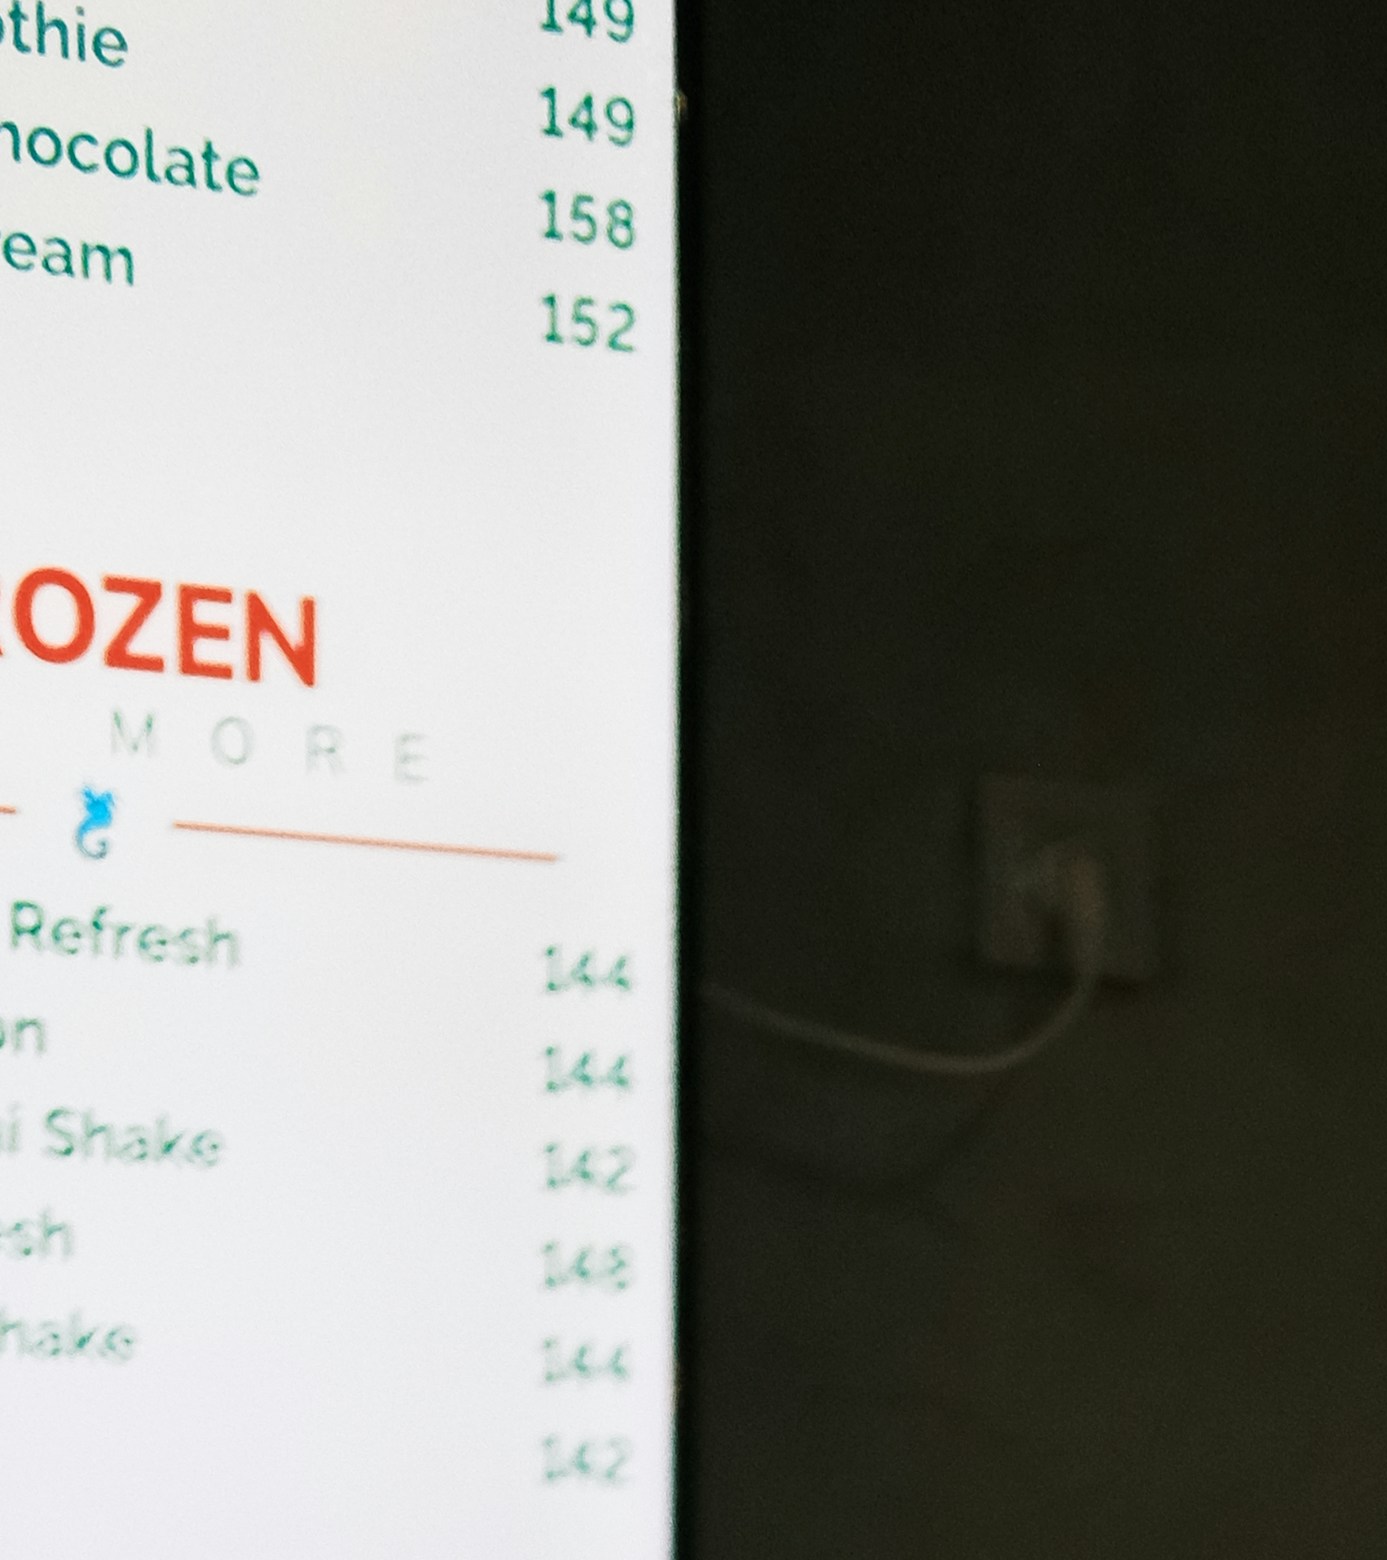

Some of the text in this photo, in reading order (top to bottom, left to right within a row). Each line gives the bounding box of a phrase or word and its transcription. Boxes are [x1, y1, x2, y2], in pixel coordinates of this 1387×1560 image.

[0, 0, 128, 68] thie
[539, 0, 635, 43] 149
[539, 85, 635, 147] 149
[539, 189, 635, 250] 158
[541, 293, 637, 353] 152
[0, 566, 317, 688] OZEN
[109, 708, 430, 784] MORE
[10, 900, 241, 969] Refresh
[542, 943, 633, 994] 144
[0, 1015, 46, 1056] n
[542, 1044, 633, 1093] 144
[44, 1106, 225, 1169] Shake
[542, 1142, 635, 1194] 142
[0, 1206, 73, 1263] sh
[540, 1434, 635, 1485] 142
